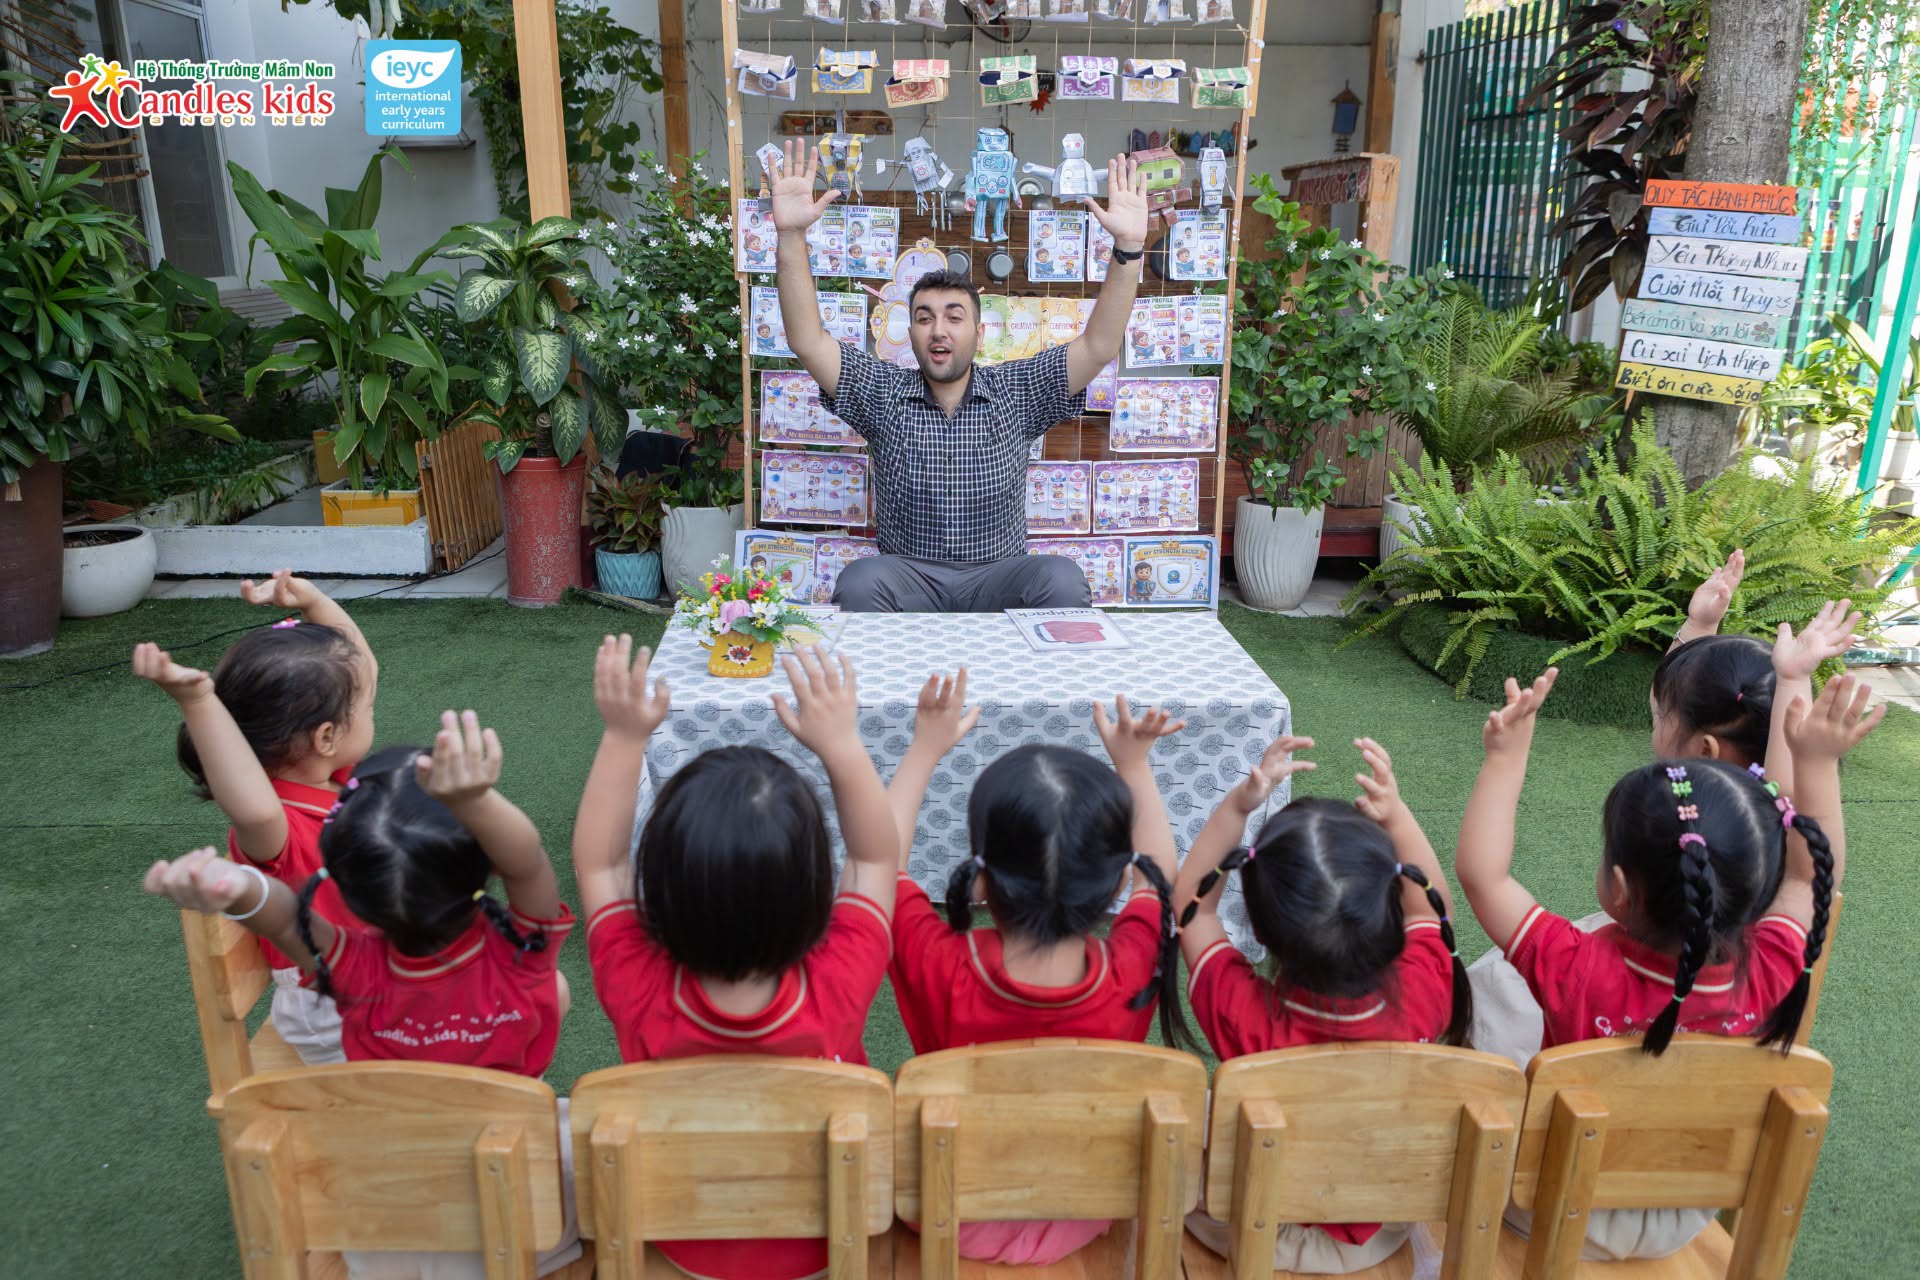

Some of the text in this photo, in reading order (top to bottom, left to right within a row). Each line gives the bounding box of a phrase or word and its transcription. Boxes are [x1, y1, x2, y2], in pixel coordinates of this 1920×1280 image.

[1645, 185, 1676, 205] QUY
[1681, 182, 1707, 207] TẮC
[1750, 188, 1790, 213] PHÚC
[373, 1028, 419, 1047] andles
